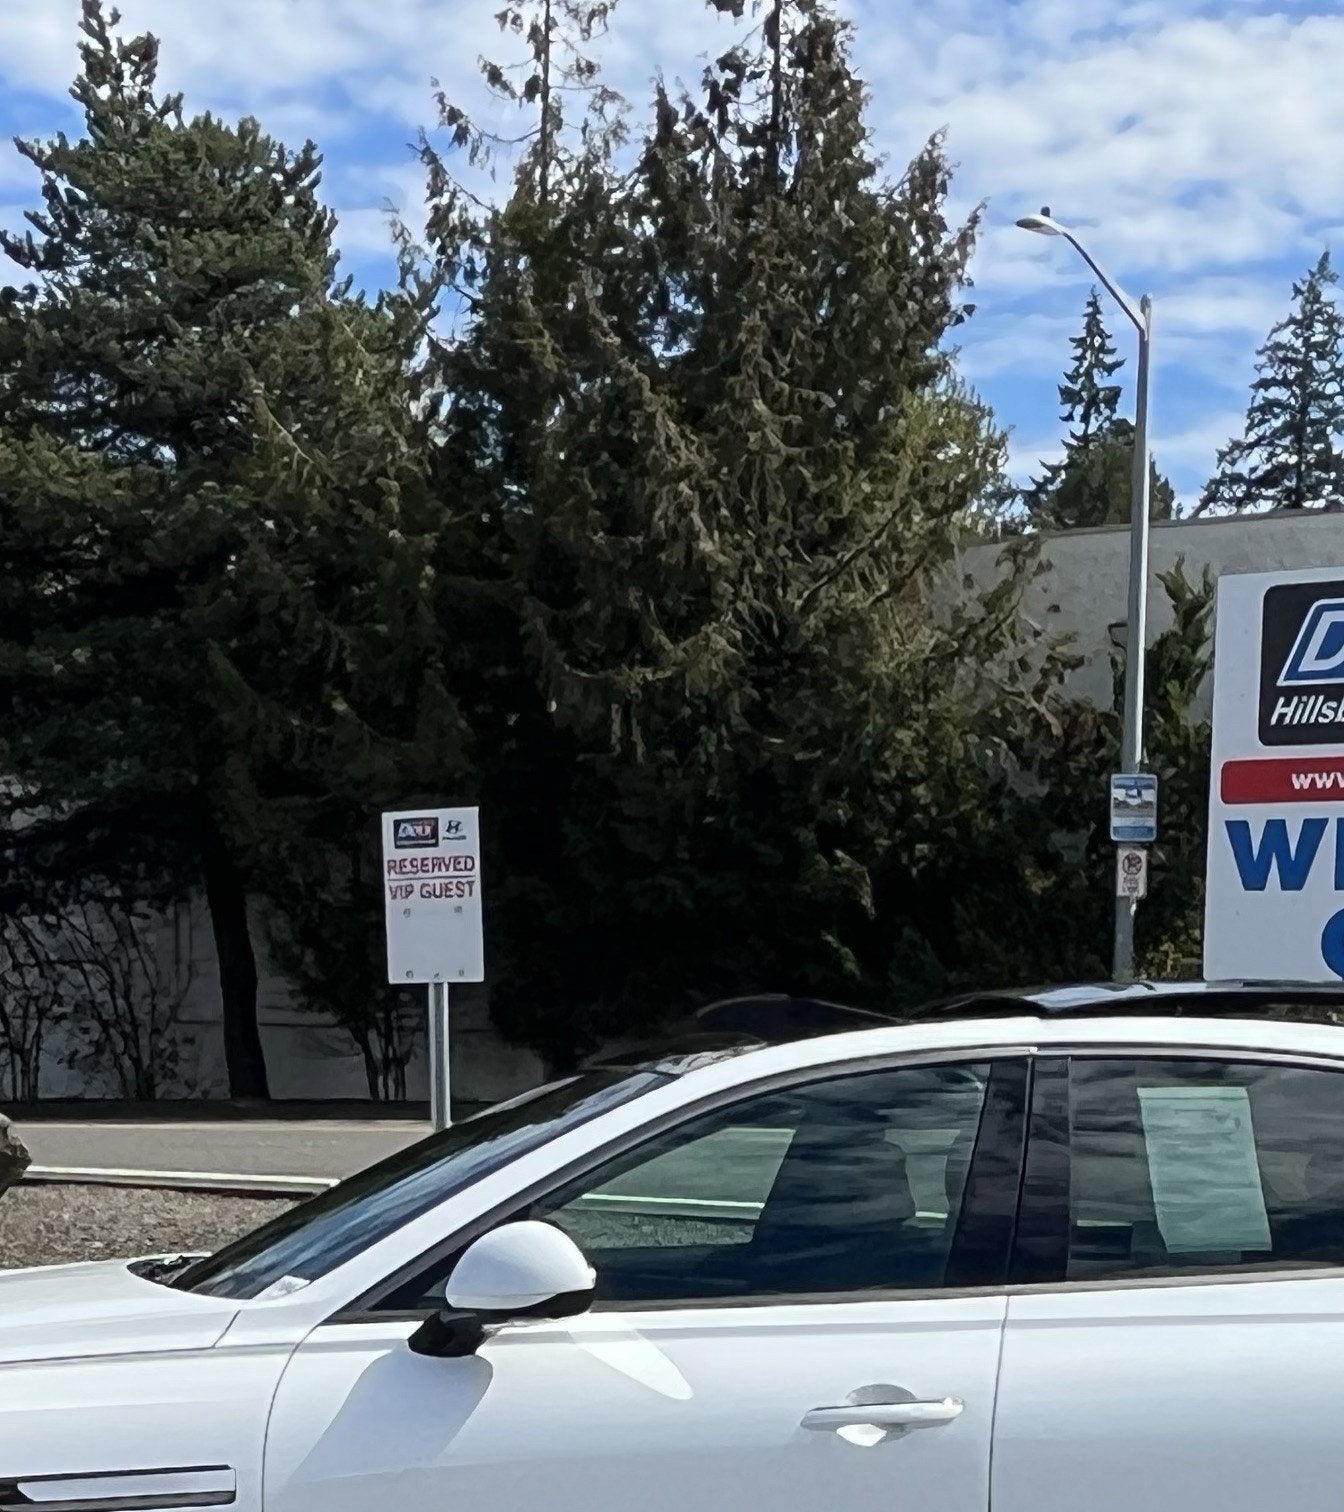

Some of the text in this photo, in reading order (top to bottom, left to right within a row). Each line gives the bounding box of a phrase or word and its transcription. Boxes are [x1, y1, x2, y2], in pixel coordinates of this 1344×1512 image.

[387, 854, 475, 875] RESERVED
[389, 880, 475, 900] VIP GUEST
